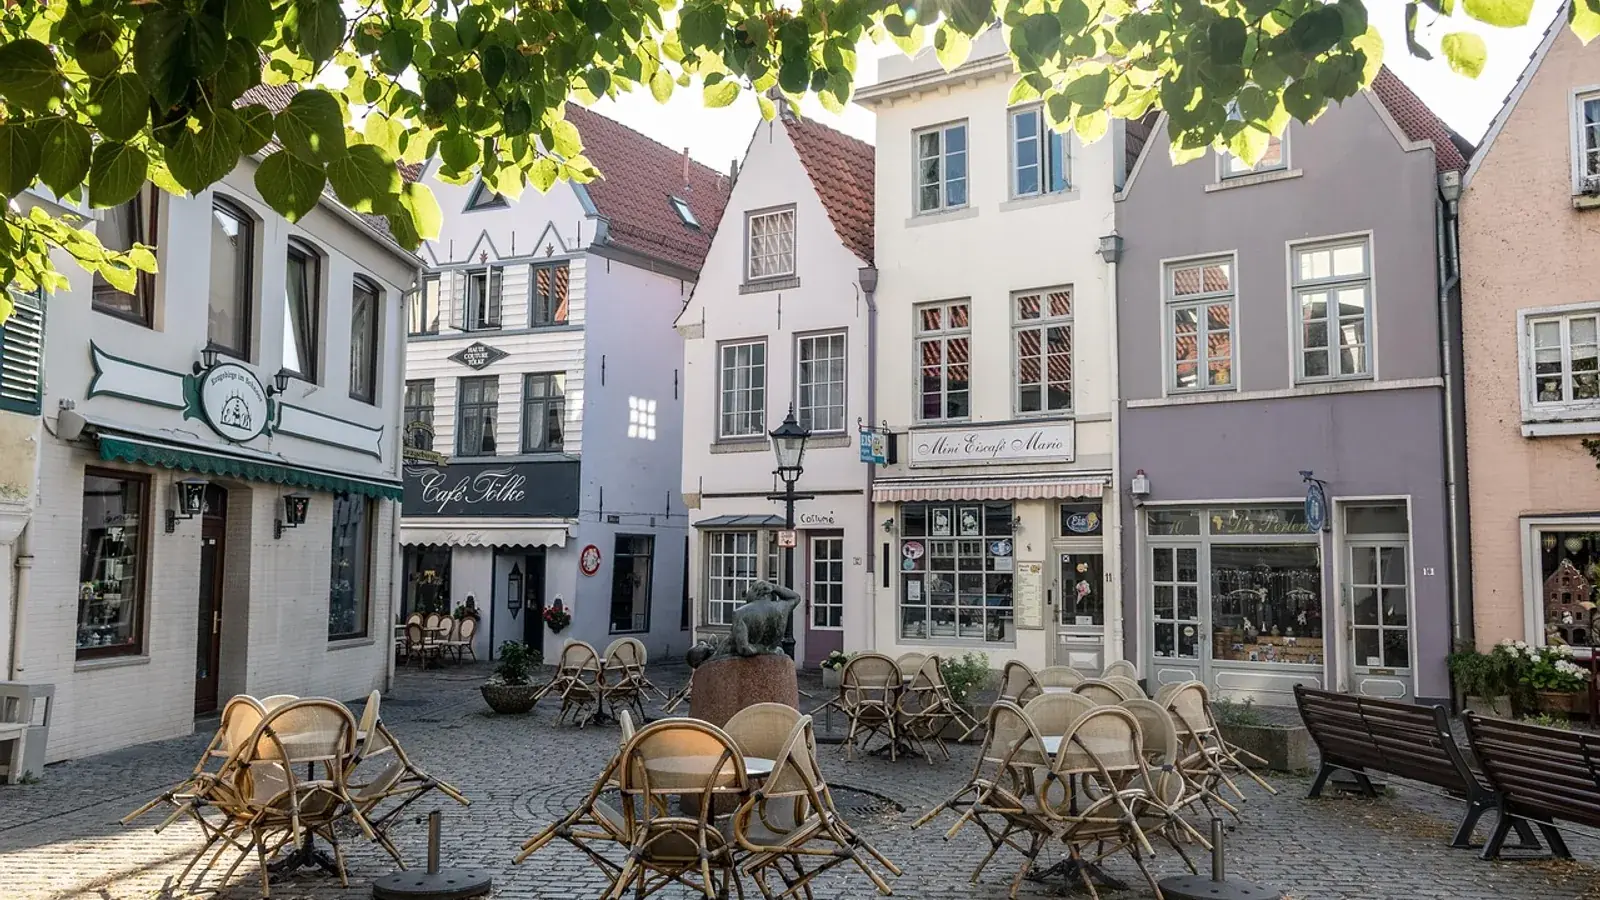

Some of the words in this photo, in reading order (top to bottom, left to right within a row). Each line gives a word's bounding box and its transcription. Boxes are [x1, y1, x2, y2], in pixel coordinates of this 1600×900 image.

[918, 436, 960, 455] Mini
[1011, 431, 1063, 450] Mario
[420, 473, 470, 513] Café
[465, 465, 526, 503] Tölke
